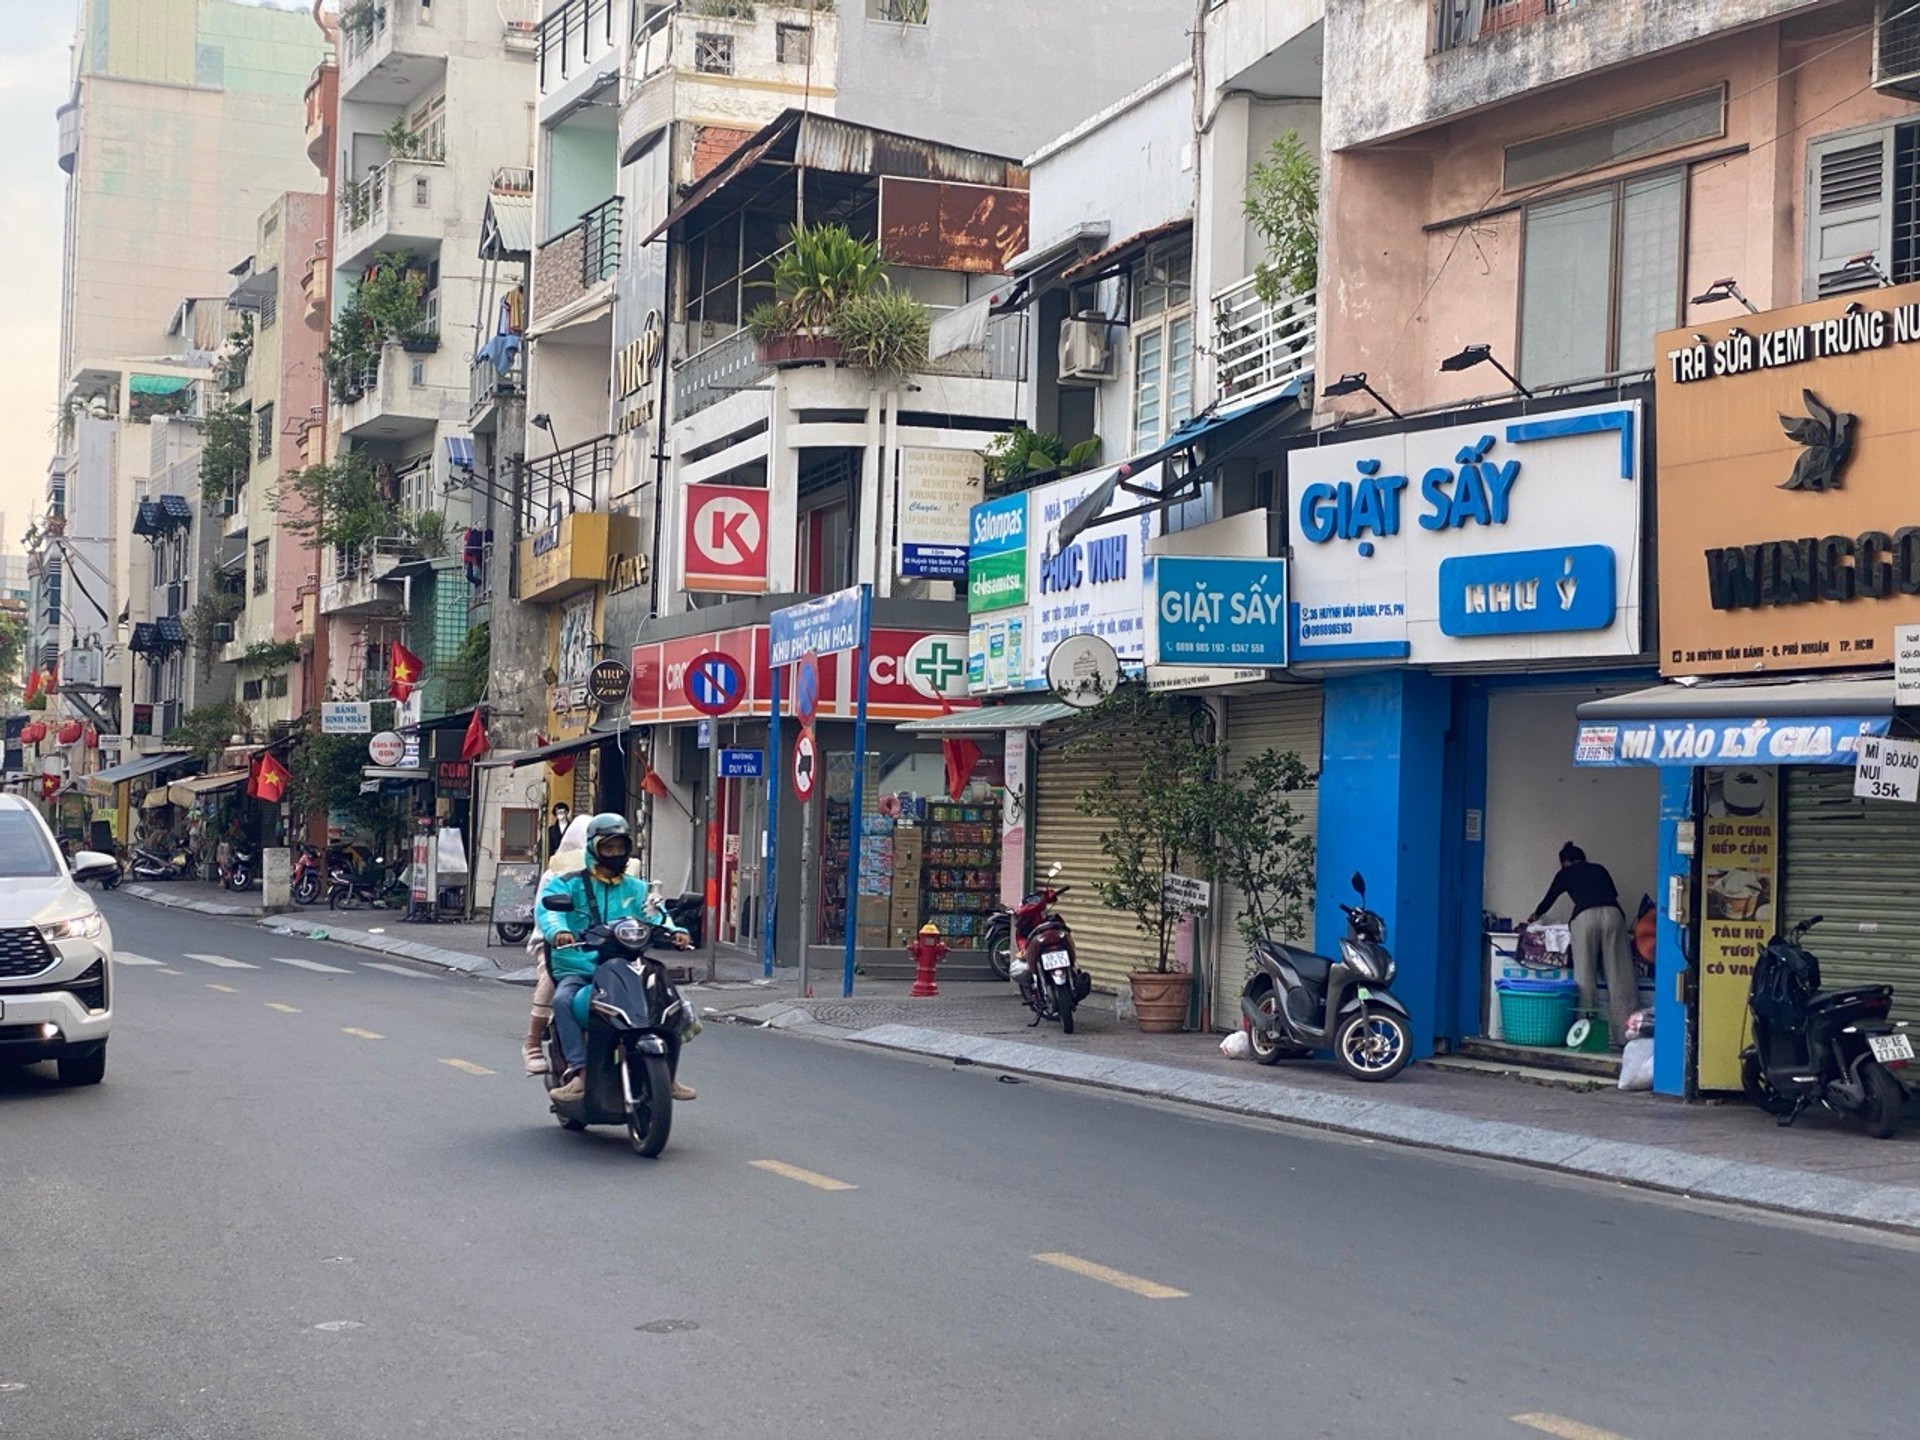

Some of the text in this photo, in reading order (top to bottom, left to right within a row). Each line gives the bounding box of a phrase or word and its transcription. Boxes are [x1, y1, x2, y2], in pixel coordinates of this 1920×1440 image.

[1668, 334, 1707, 383] TRÀ
[1713, 328, 1753, 376] SỮA
[1759, 326, 1806, 368] KEM
[1810, 303, 1885, 357] TRỨNG
[1300, 435, 1522, 558] GIẶT SẤY
[974, 508, 1022, 545] Salonpas
[1464, 556, 1578, 615] NHƯ Ý
[1161, 574, 1282, 633] GIẶT SẤY
[1394, 603, 1405, 616] PN
[772, 639, 790, 664] KHU
[832, 619, 854, 648] HÓA
[1725, 646, 1741, 660] VĂN
[1743, 643, 1764, 659] BÁNH
[1782, 640, 1799, 656] PHÚ
[1801, 640, 1830, 656] NHUẬN
[1840, 640, 1851, 652] TP.
[1854, 638, 1874, 651] HCM
[596, 668, 624, 680] MRP
[325, 715, 343, 724] SINH
[1621, 724, 1656, 758] MÌ
[1659, 723, 1716, 759] XÀO
[1768, 726, 1833, 757] GIA
[731, 751, 754, 760] ĐƯỜNG
[1865, 742, 1880, 759] MÌ
[728, 761, 757, 774] DUY TÂN
[1885, 750, 1918, 769] BÒ XÀO
[1859, 765, 1881, 780] NUI
[1871, 781, 1901, 798] 35k
[1708, 824, 1772, 837] SỮA CHUA
[1711, 839, 1737, 854] NẾP
[1711, 925, 1741, 939] TÀU
[1720, 945, 1755, 957] TƯƠI
